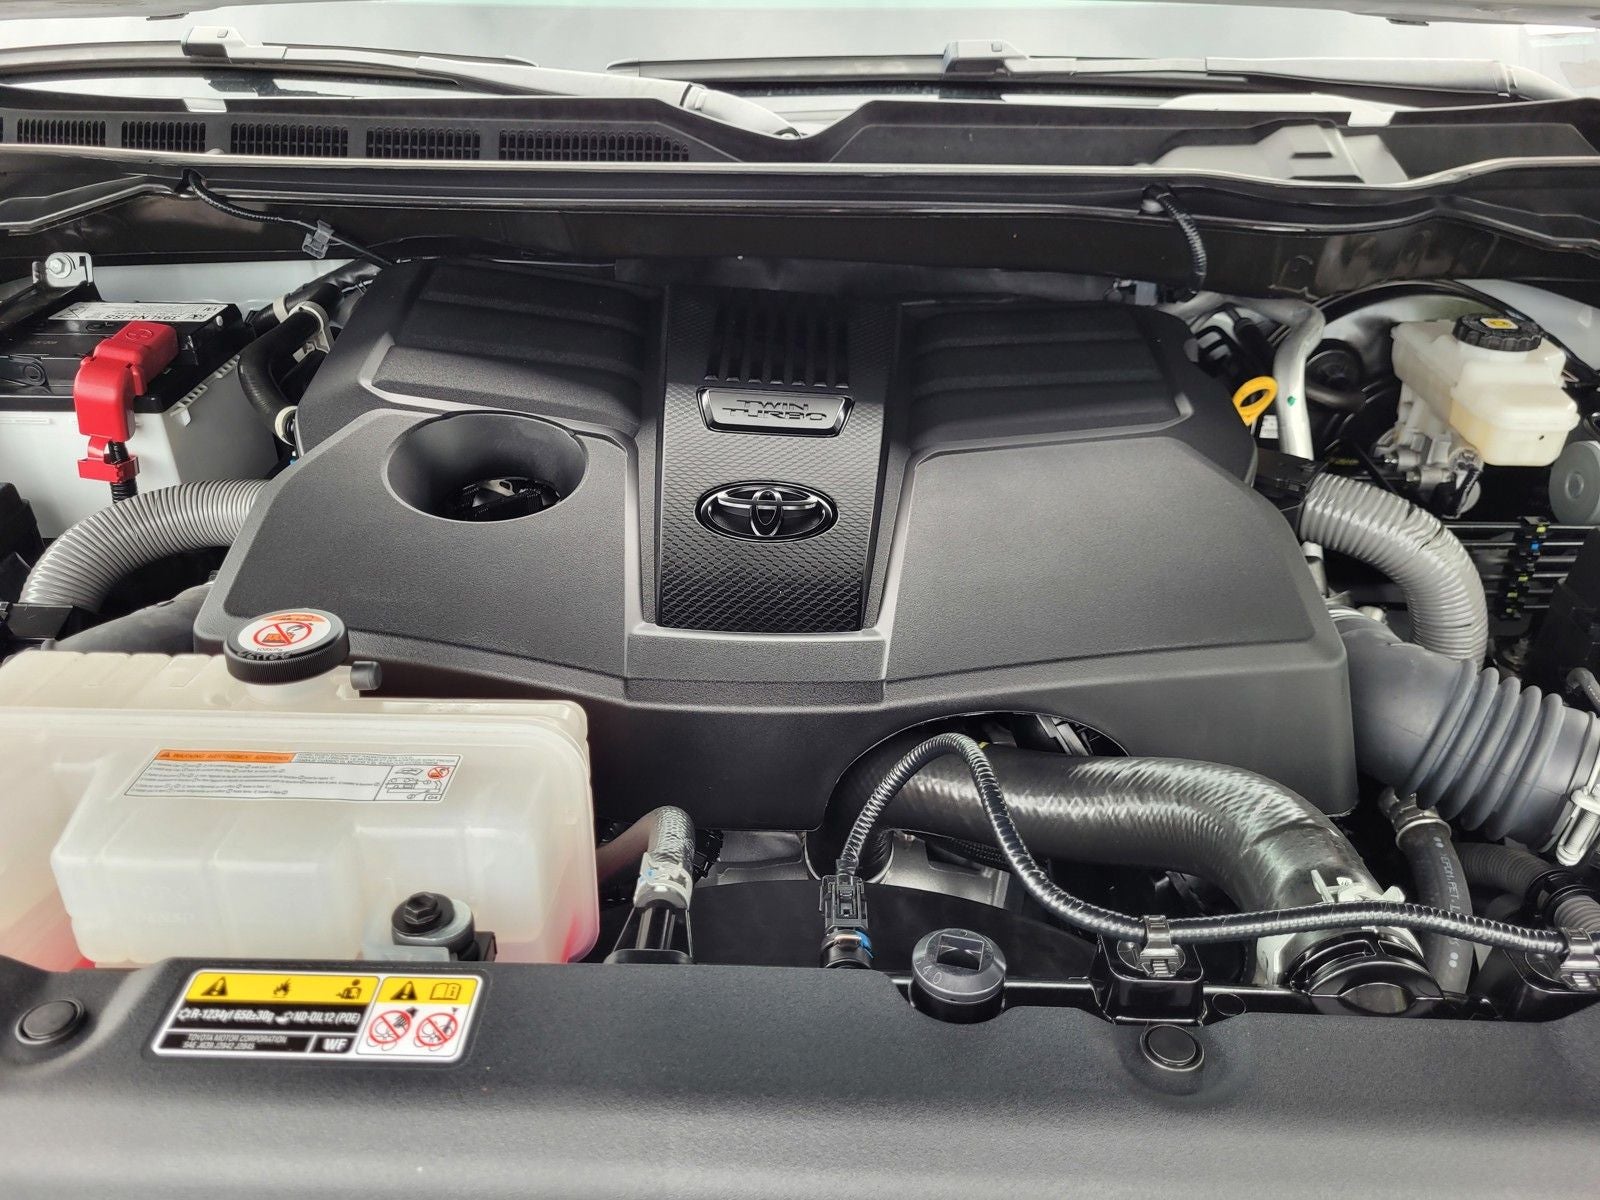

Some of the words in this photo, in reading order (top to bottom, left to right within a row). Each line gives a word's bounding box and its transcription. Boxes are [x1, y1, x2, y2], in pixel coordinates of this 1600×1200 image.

[736, 399, 809, 411] TWIN
[721, 407, 827, 421] TURBO
[190, 1008, 234, 1023] R-1234yf
[233, 1009, 275, 1024] 650±30g
[335, 1012, 362, 1024] (POE)
[187, 1033, 213, 1041] TOYOTA
[213, 1034, 239, 1042] MOTOR
[239, 1034, 288, 1044] CORPORATION
[323, 1038, 348, 1051] WF
